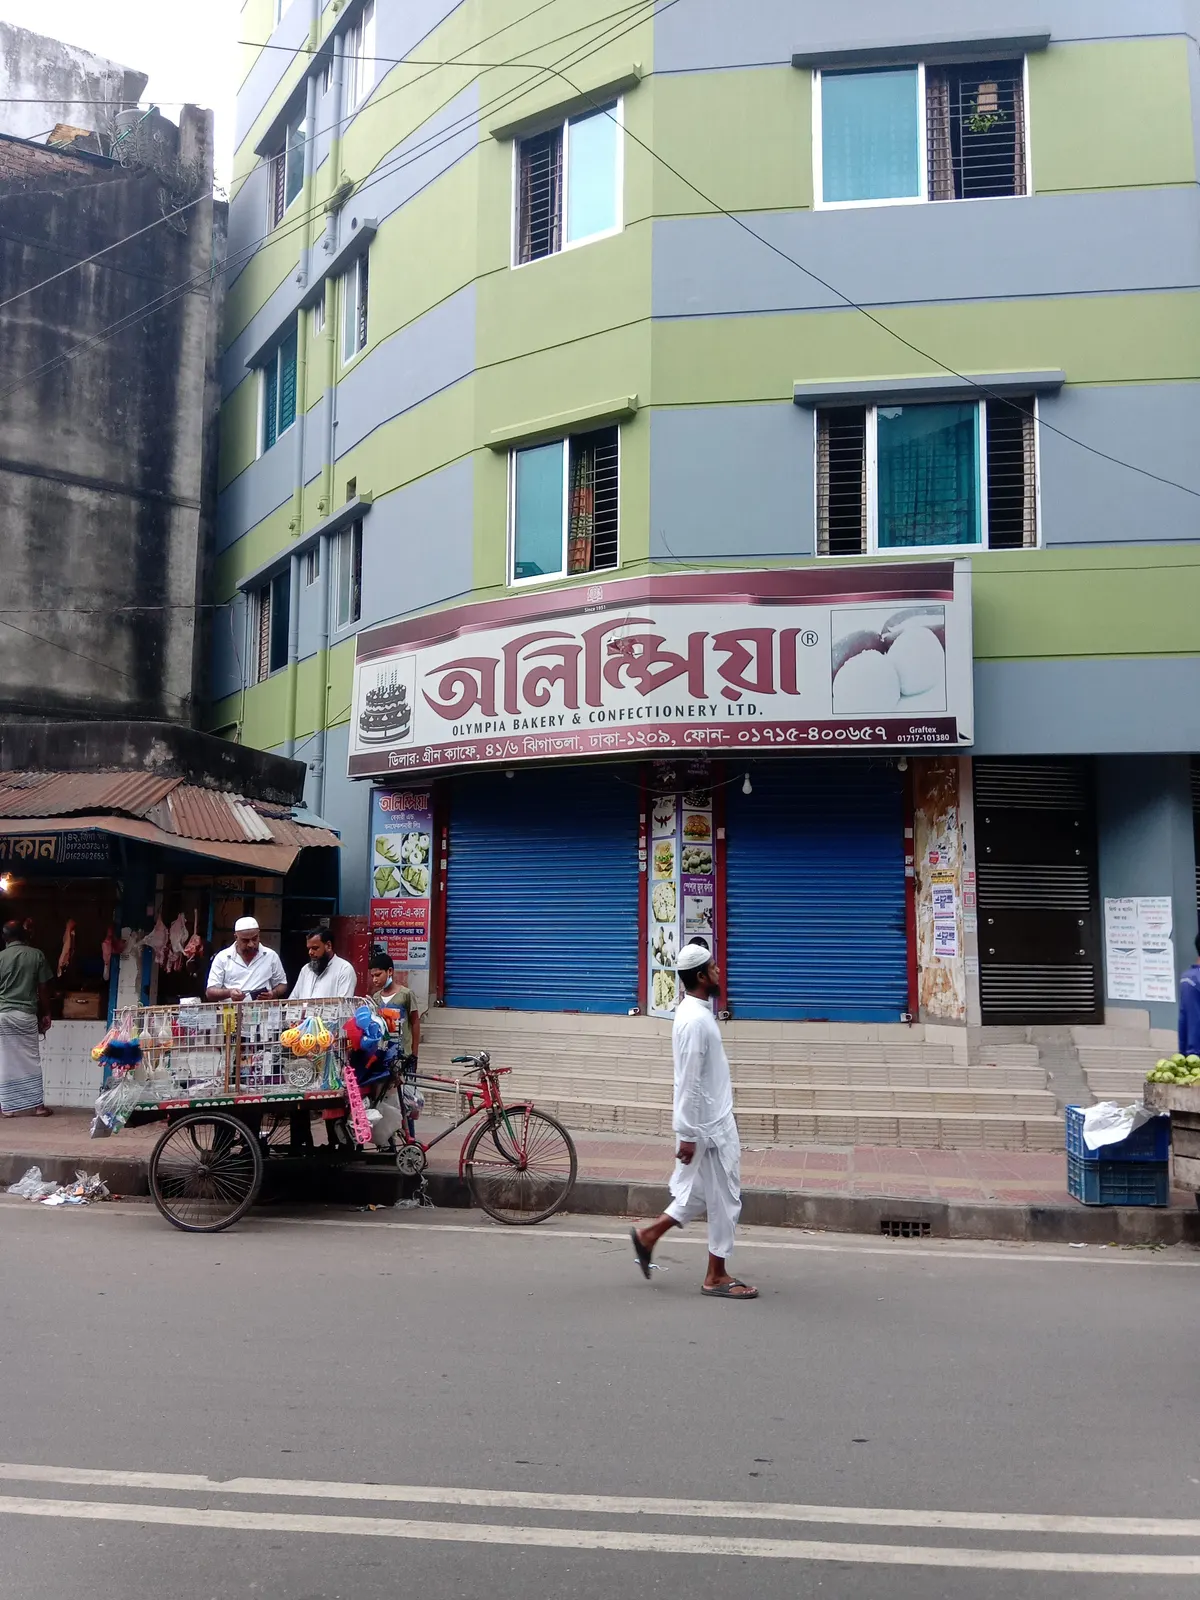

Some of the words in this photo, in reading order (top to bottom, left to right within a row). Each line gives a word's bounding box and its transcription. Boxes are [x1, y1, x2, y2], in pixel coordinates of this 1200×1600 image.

[452, 720, 506, 737] OLYMPIA
[513, 714, 565, 731] BAKERY
[572, 712, 581, 725] &
[589, 704, 718, 724] CONFECTIONERY
[727, 703, 763, 717] LTD.
[909, 726, 937, 735] Graftex
[422, 746, 442, 764] গ্রীন
[444, 744, 481, 761] ক্যাফে,
[485, 740, 519, 758] ৪১/৬
[589, 729, 676, 747] ঢাকা-১২০৯,
[738, 727, 888, 743] ০১৭১৫-৪০০৬৫৭
[898, 734, 950, 742] 01717-101380
